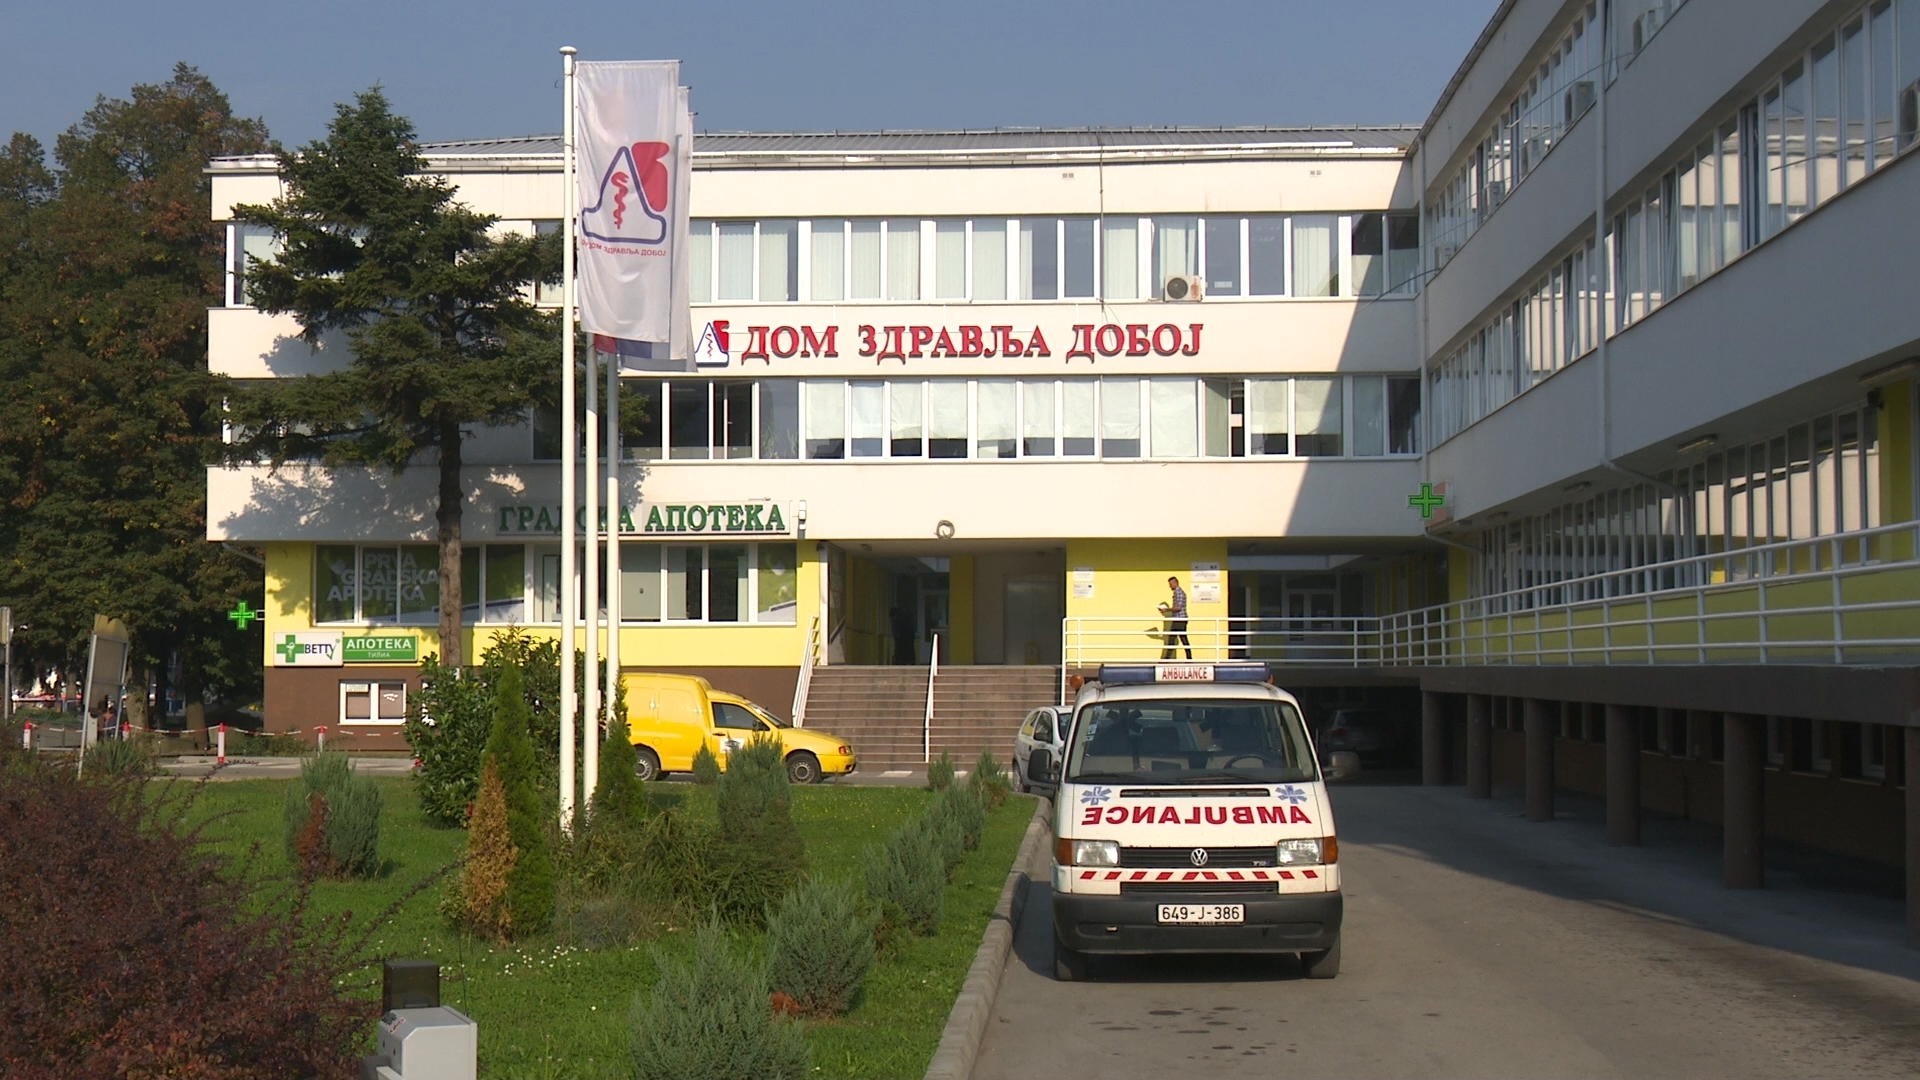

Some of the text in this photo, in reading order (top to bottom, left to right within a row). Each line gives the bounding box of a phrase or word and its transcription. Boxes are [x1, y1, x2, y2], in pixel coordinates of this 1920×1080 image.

[604, 246, 639, 256] ЗДРАВЉА
[641, 249, 666, 257] ДОБОЈ
[741, 323, 1204, 366] ДОМ ЗДРАВЉА ДОБОЈ
[644, 503, 786, 532] АПОТЕКА
[346, 638, 412, 649] АПОТЕКА
[1162, 667, 1208, 680] AMBULANCE
[1162, 906, 1240, 920] 649-J-386
